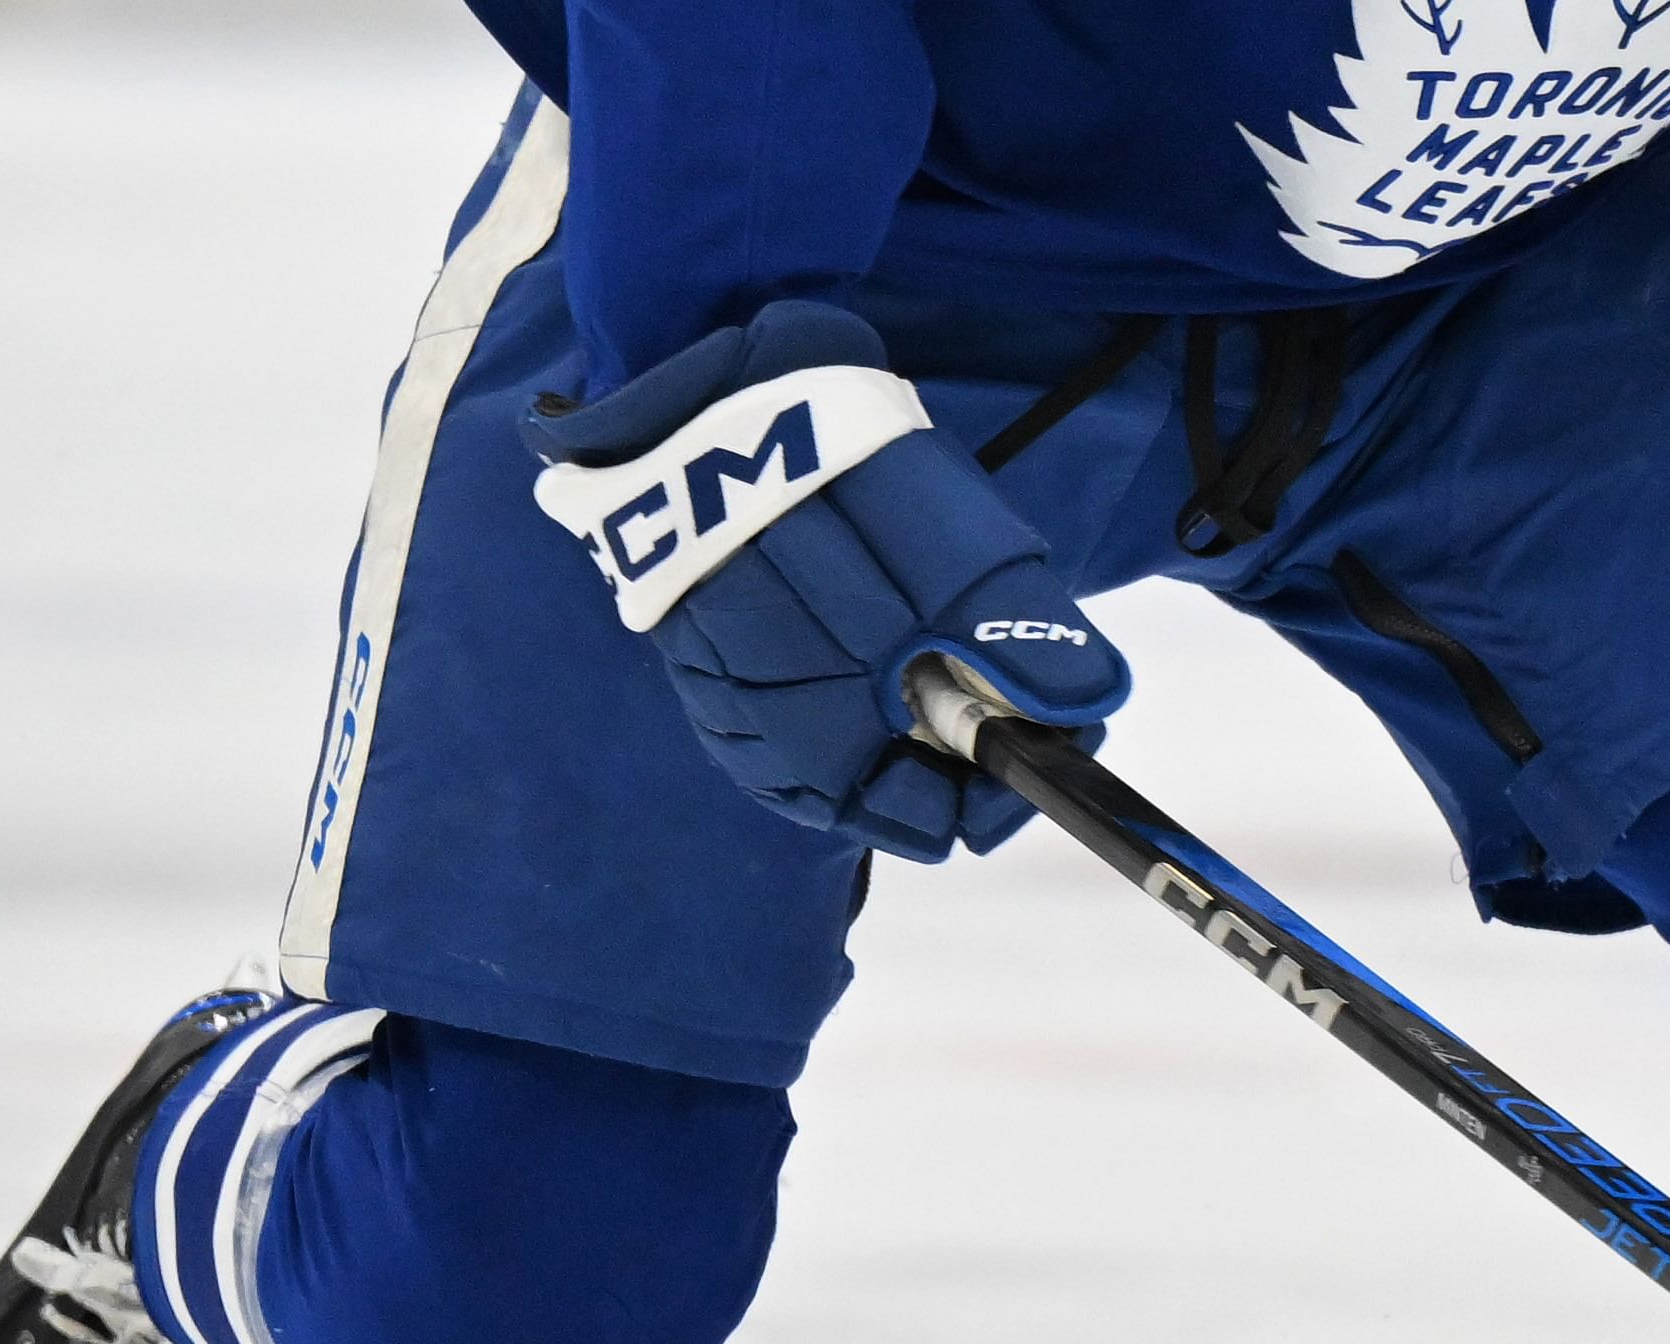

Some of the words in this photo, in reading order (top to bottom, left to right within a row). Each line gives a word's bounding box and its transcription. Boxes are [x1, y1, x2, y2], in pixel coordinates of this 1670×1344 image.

[1406, 123, 1643, 177] MAPLE
[973, 620, 1088, 646] CCM
[1143, 862, 1350, 1032] CCM
